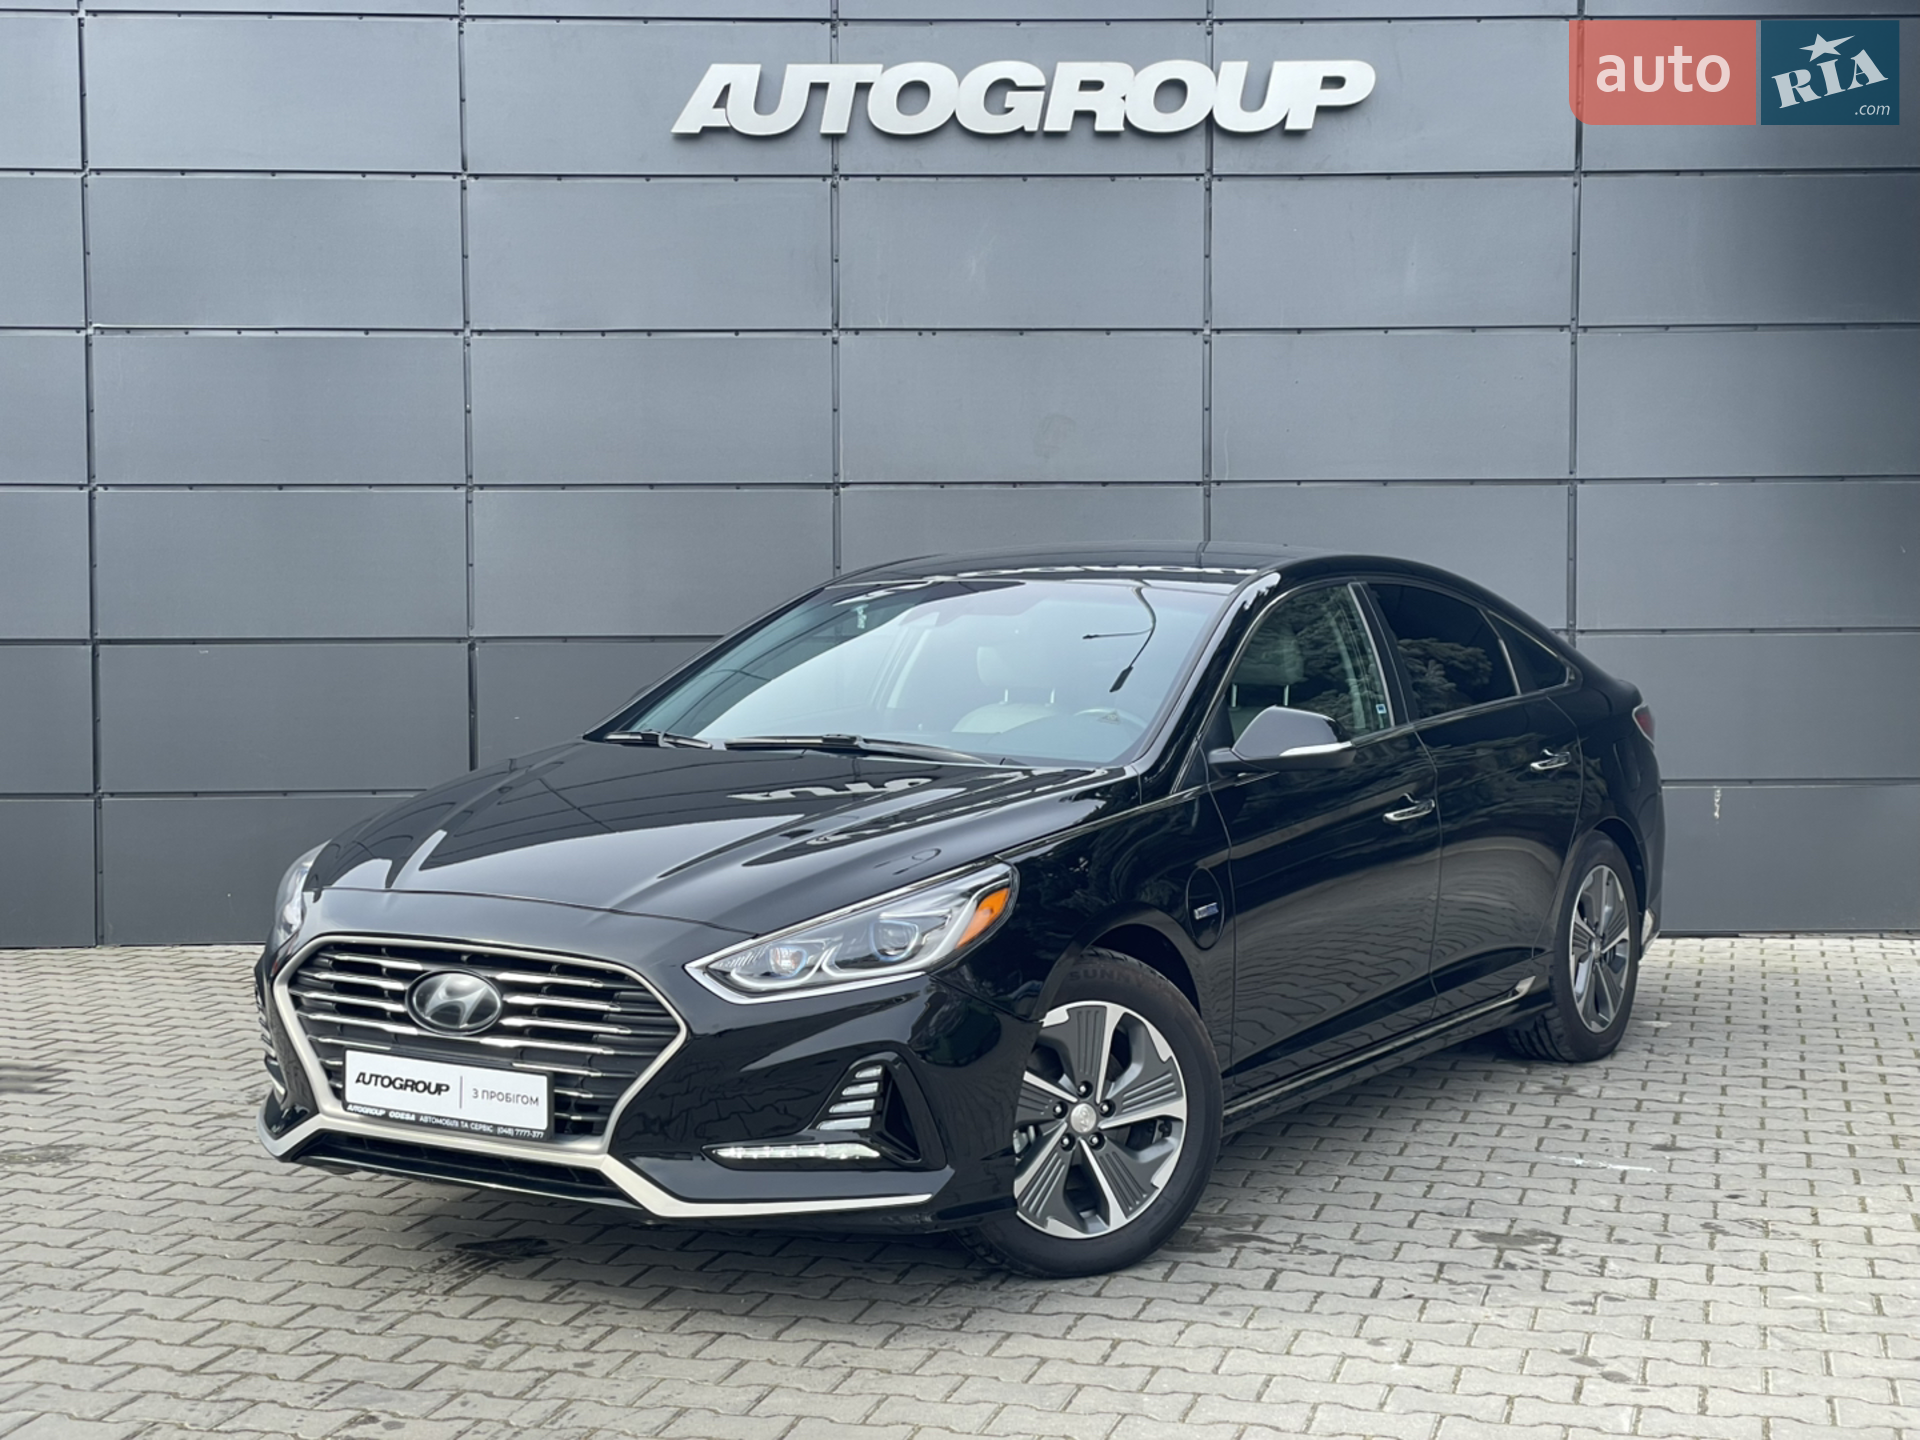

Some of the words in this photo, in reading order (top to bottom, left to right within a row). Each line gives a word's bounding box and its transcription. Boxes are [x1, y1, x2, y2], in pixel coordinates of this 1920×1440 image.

[671, 59, 1376, 135] AUTOGROUP
[355, 1071, 450, 1096] AUTOGROUP
[482, 1090, 539, 1106] ПРОБІГОМ
[346, 1103, 386, 1116] AUTOGROUP
